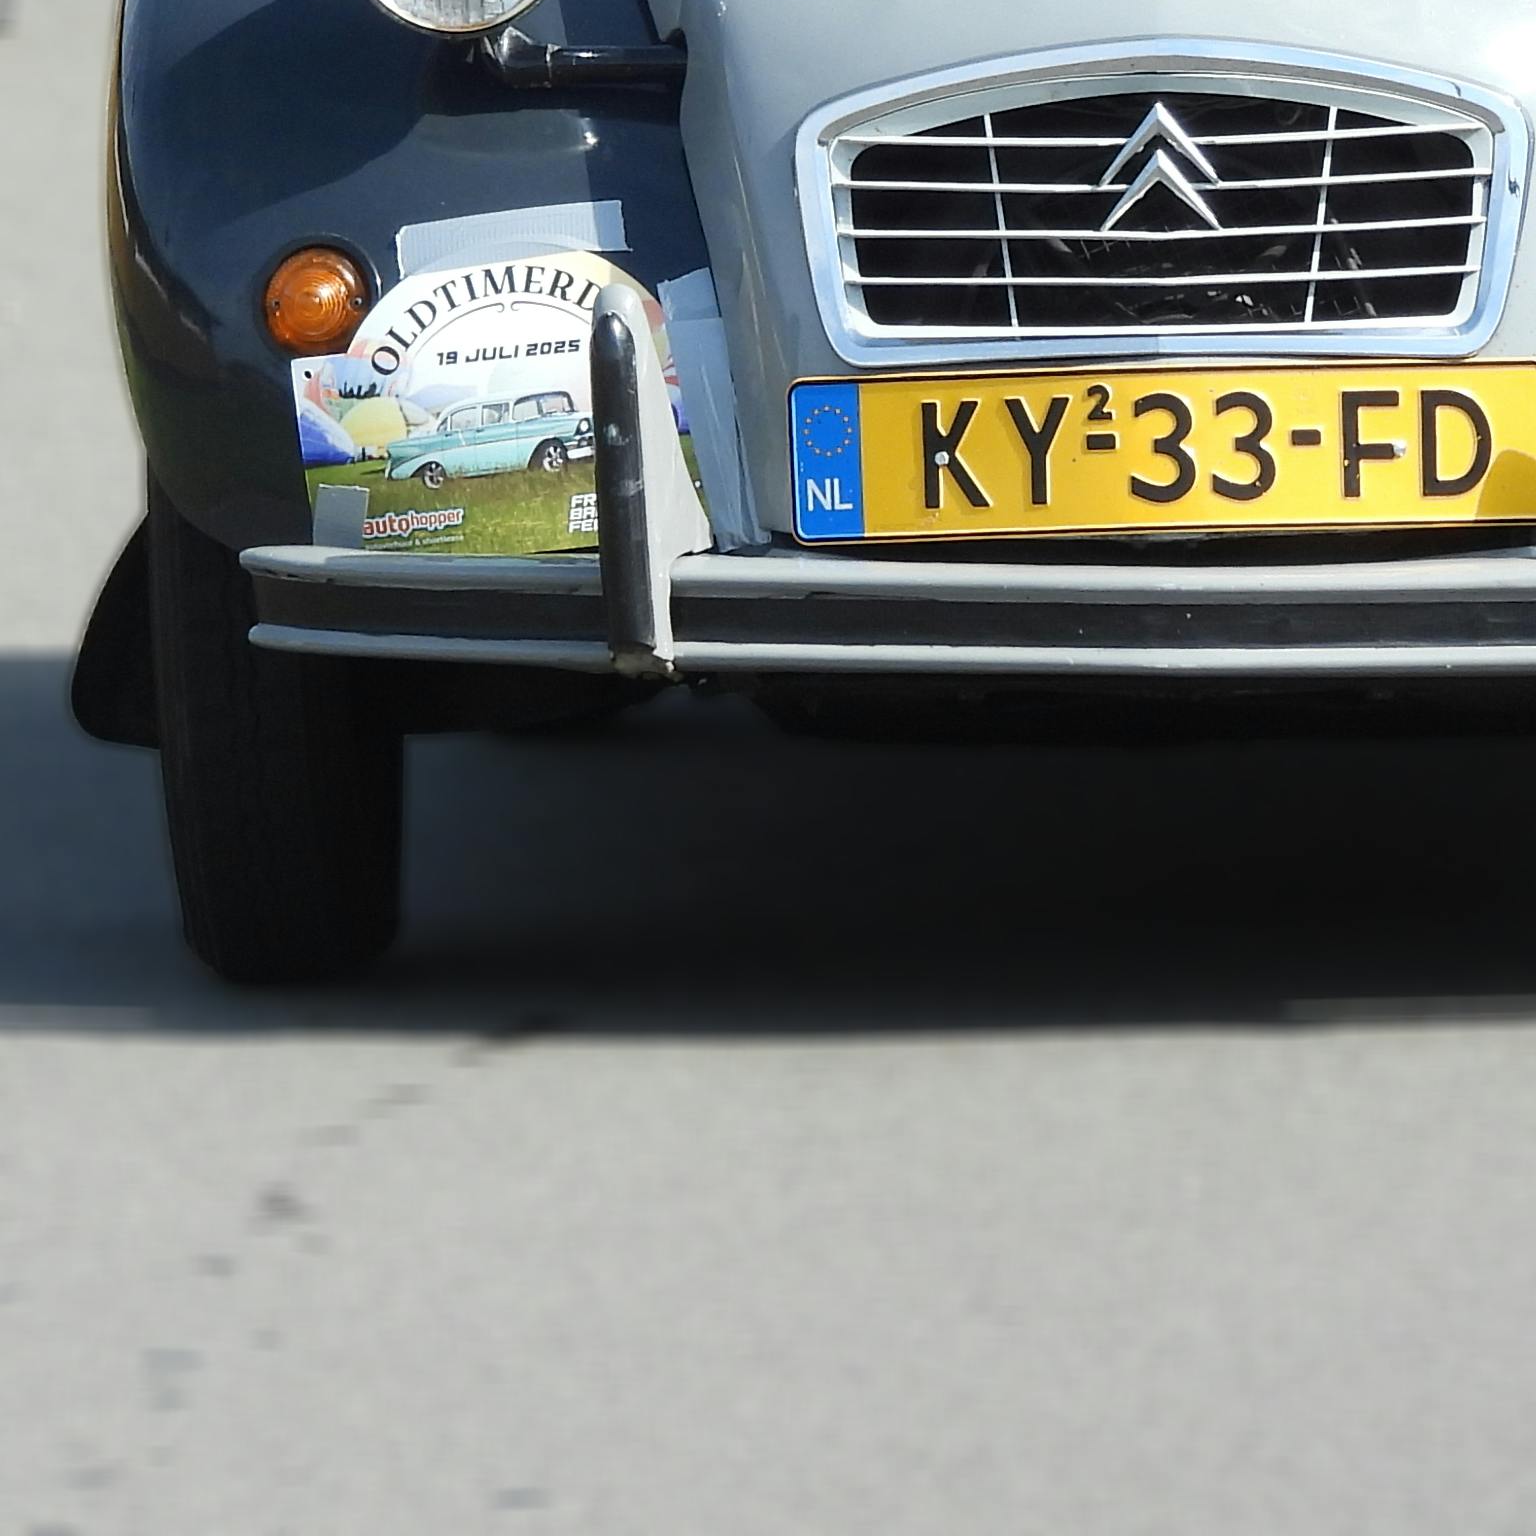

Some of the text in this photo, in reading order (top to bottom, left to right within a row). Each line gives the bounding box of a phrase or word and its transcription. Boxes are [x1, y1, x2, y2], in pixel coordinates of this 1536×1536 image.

[437, 339, 581, 365] 19 JULI 2025
[807, 478, 853, 511] NL
[363, 510, 462, 536] autohopper
